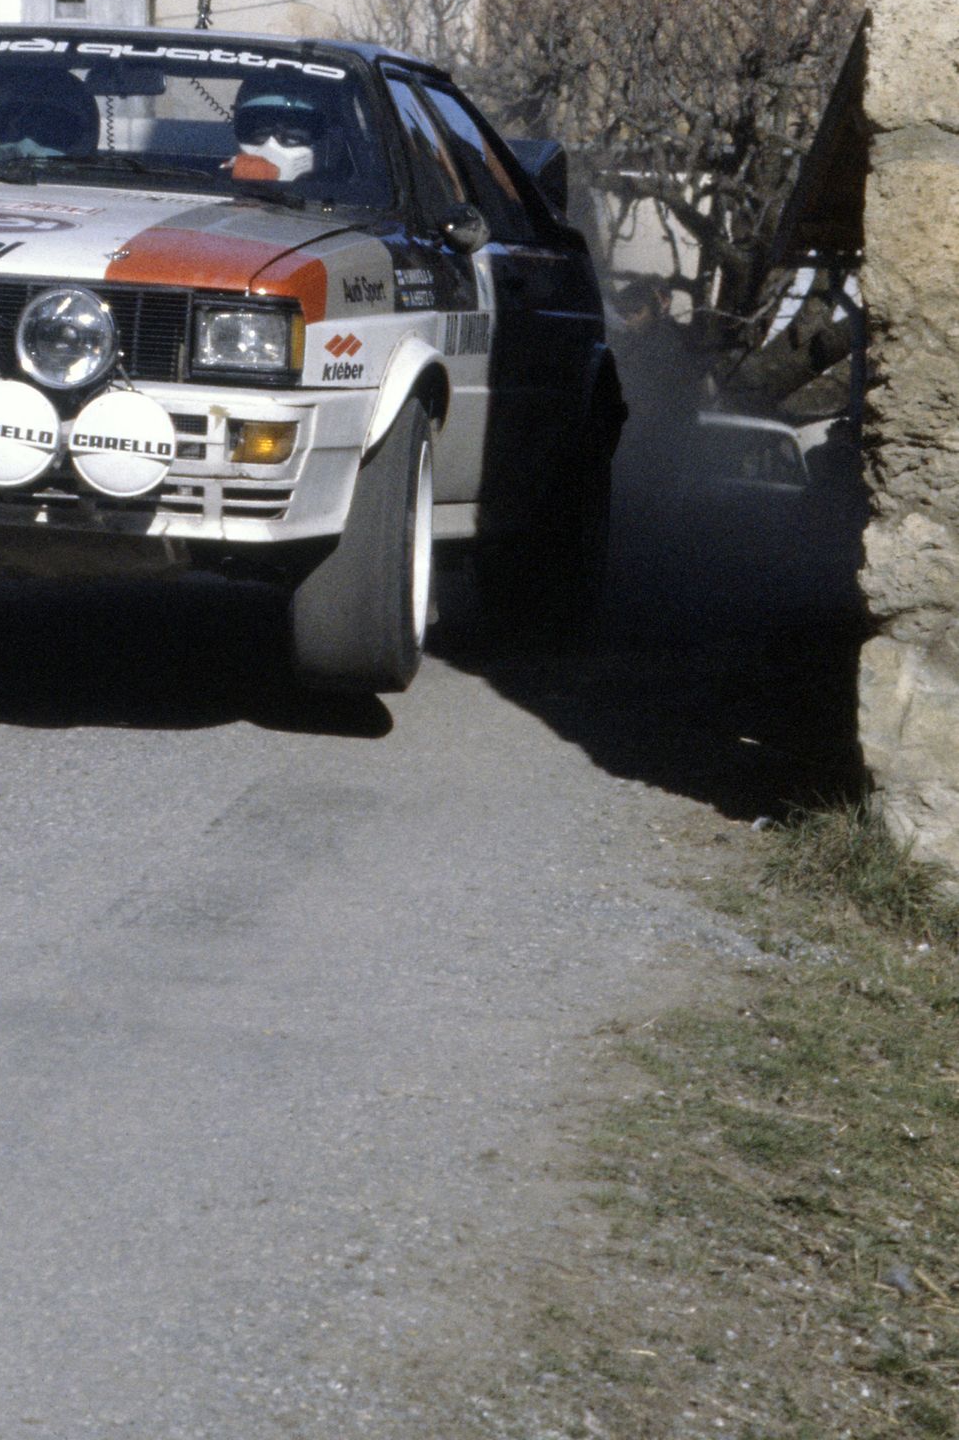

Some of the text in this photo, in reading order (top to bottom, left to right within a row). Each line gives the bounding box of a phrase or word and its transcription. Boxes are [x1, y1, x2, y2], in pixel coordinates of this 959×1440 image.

[75, 42, 346, 80] quattro
[343, 276, 363, 303] Audi
[361, 275, 387, 307] Sport
[72, 433, 172, 456] CARELLO
